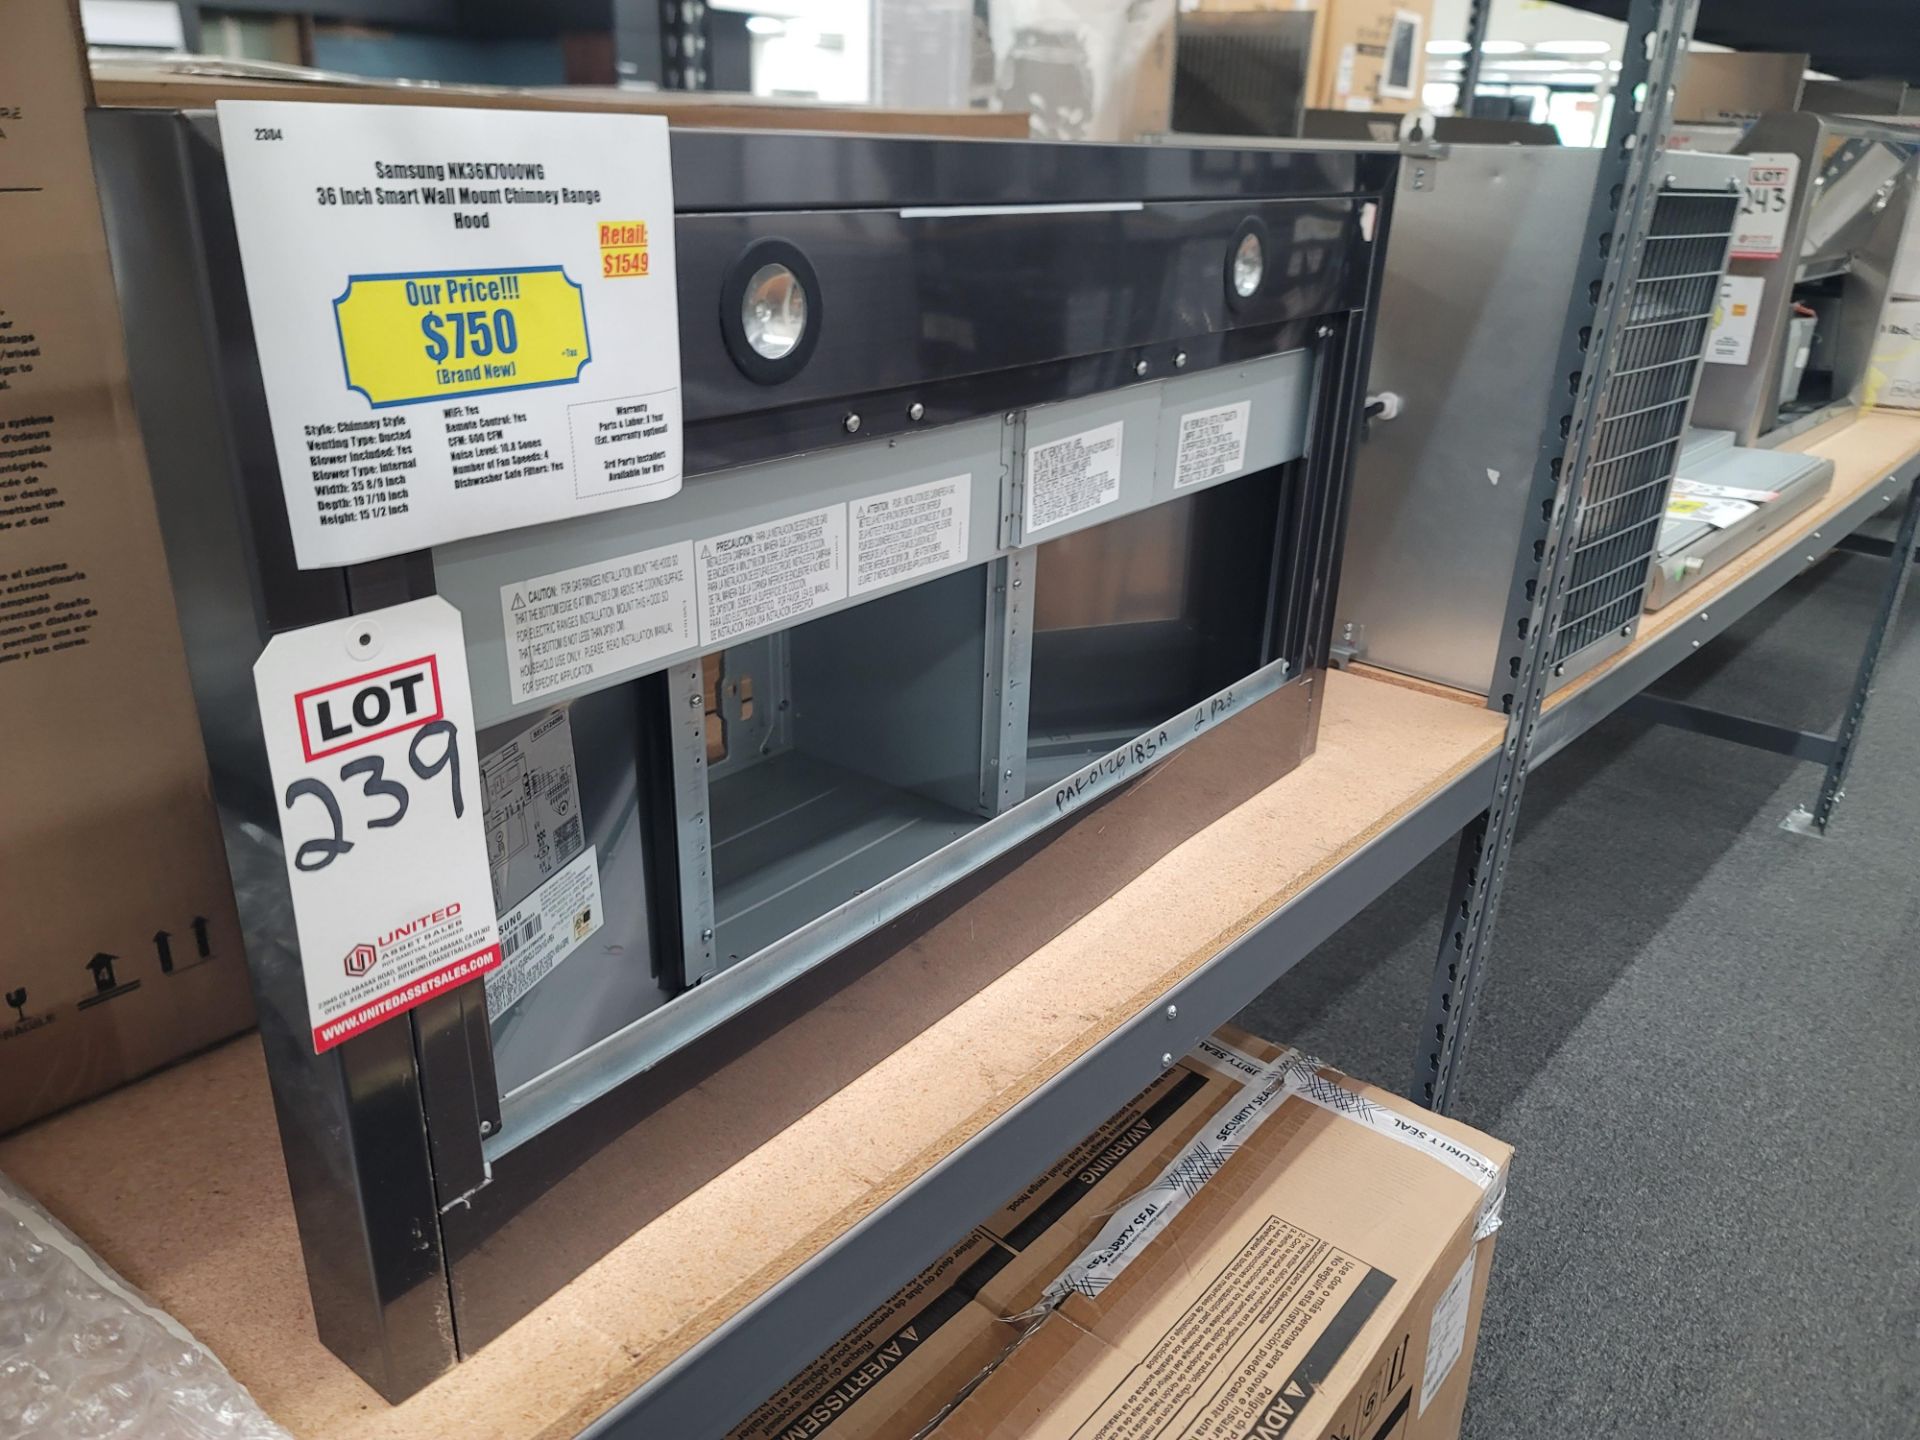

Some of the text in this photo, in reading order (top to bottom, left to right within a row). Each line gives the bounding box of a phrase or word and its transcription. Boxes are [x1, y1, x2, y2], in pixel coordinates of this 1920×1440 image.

[375, 160, 444, 181] Samsung
[1754, 171, 1782, 181] LOT
[317, 187, 601, 206] 36 Inch Smart Wall Mount Chimney Range
[455, 212, 490, 230] Hood
[601, 224, 648, 245] Retail:
[604, 252, 649, 274] $1549
[406, 276, 520, 306] Our Price!!!
[422, 309, 517, 365] $750
[436, 361, 516, 385] (Brand New)
[465, 405, 479, 415] Yes
[616, 404, 647, 415] Warranty
[304, 416, 405, 436] Style: Chimney Style
[446, 414, 527, 433] Remote Control: Yes
[599, 421, 617, 431] Parts
[307, 429, 411, 450] Venting Type: Ducted
[448, 435, 467, 447] CFM:
[487, 429, 503, 440] CFM
[611, 430, 641, 442] warranty
[310, 445, 412, 466] Blower Included: Yes
[450, 450, 473, 461] Noise
[475, 445, 498, 457] Level:
[518, 439, 542, 449] Sones
[312, 458, 416, 481] Blower Type: Internal
[453, 449, 549, 475] Number of Fan Speeds: 4
[618, 457, 635, 467] Party
[315, 484, 350, 496] Width:
[386, 475, 406, 486] Inch
[455, 462, 564, 489] Dishwasher Safe Filters: Yes
[609, 469, 640, 481] Available
[317, 499, 352, 511] Depth:
[388, 489, 408, 500] Inch
[320, 503, 408, 525] Height: 15 1/2 Inch
[528, 586, 557, 603] CAUTION:
[316, 673, 424, 742] LOT
[285, 719, 465, 872] 239
[378, 902, 461, 947] UNITED
[498, 911, 522, 935] SUNG
[382, 920, 463, 960] ASSET SALES
[322, 951, 494, 1041] WWW.UNITEDASSETSALES.COM
[1198, 1041, 1227, 1060] SEAL
[1215, 1089, 1272, 1143] SECURITY SEA
[1075, 1126, 1147, 1185] WARNING
[1391, 1117, 1496, 1179] SECURITY SEAL
[1045, 1157, 1072, 1178] install
[1023, 1174, 1050, 1194] range
[1005, 1193, 1031, 1213] hood.
[1329, 1254, 1344, 1268] No
[1336, 1260, 1355, 1277] Use
[1308, 1265, 1336, 1291] seguir
[1325, 1275, 1344, 1292] dos
[1296, 1289, 1317, 1308] esta
[1321, 1289, 1331, 1297] o
[1307, 1296, 1328, 1315] más
[735, 1231, 983, 1440] Utiliser deux ou plus de personnes pour déplacer et installer
[1261, 1306, 1304, 1351] instrucción
[1275, 1311, 1313, 1350] personas
[838, 1337, 874, 1371] Risque
[1240, 1348, 1270, 1377] puede
[1262, 1348, 1284, 1369] para
[827, 1364, 844, 1381] du
[1242, 1369, 1269, 1397] mover
[799, 1375, 831, 1405] poids
[1236, 1396, 1247, 1405] e
[1238, 1384, 1274, 1420] Peligro
[1193, 1416, 1214, 1436] una
[1243, 1396, 1299, 1440] ADV
